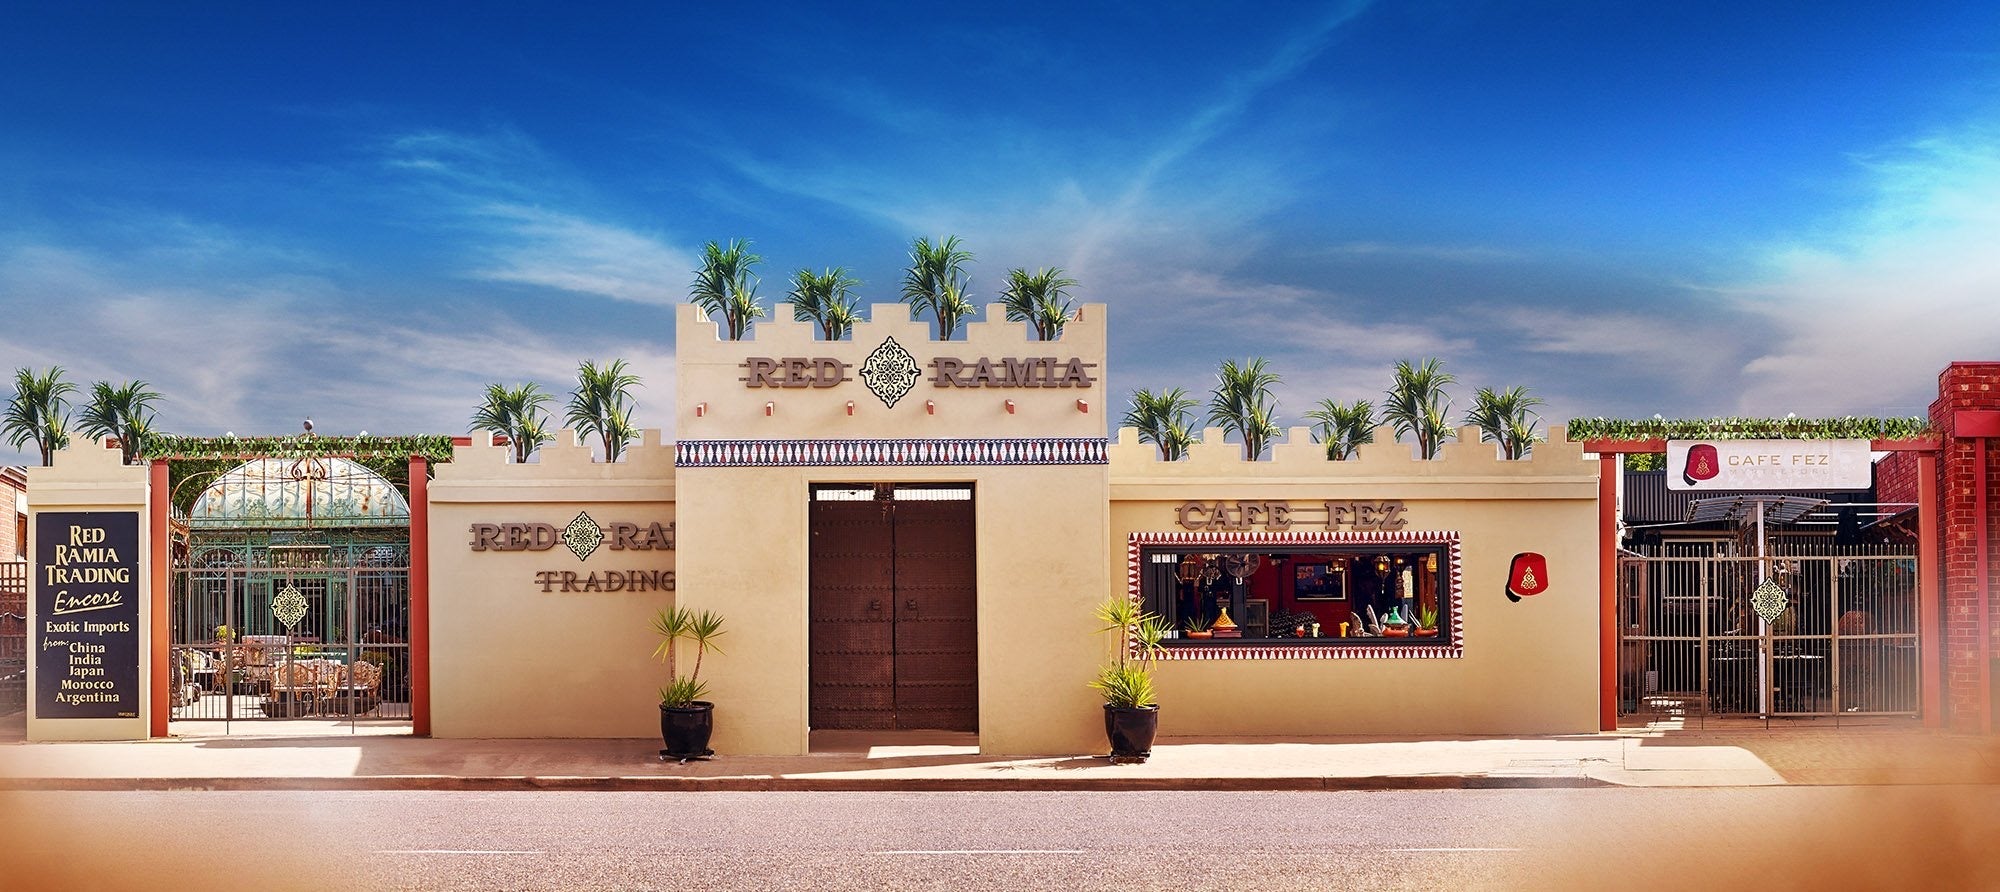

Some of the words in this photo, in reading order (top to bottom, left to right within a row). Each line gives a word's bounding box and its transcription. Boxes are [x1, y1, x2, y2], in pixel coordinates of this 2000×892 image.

[745, 357, 845, 389] RED
[933, 357, 1093, 389] RAMIA
[1728, 456, 1780, 466] CAFE
[1792, 455, 1829, 466] FEZ
[1178, 501, 1292, 531] CAFE
[1325, 501, 1404, 531] FEZ
[70, 525, 106, 547] RED
[471, 523, 557, 551] RED
[609, 521, 676, 551] RA
[55, 545, 119, 566] RAMIA
[45, 565, 130, 586] TRADING
[535, 570, 676, 593] TRADING
[54, 590, 122, 612] Encore
[46, 621, 80, 633] Exotic
[84, 621, 130, 636] Imports
[43, 636, 69, 651] from:
[69, 642, 106, 653] China
[69, 654, 102, 665] India
[70, 666, 104, 678] Japan
[61, 680, 114, 690] Morocco
[55, 692, 120, 706] Argentina
